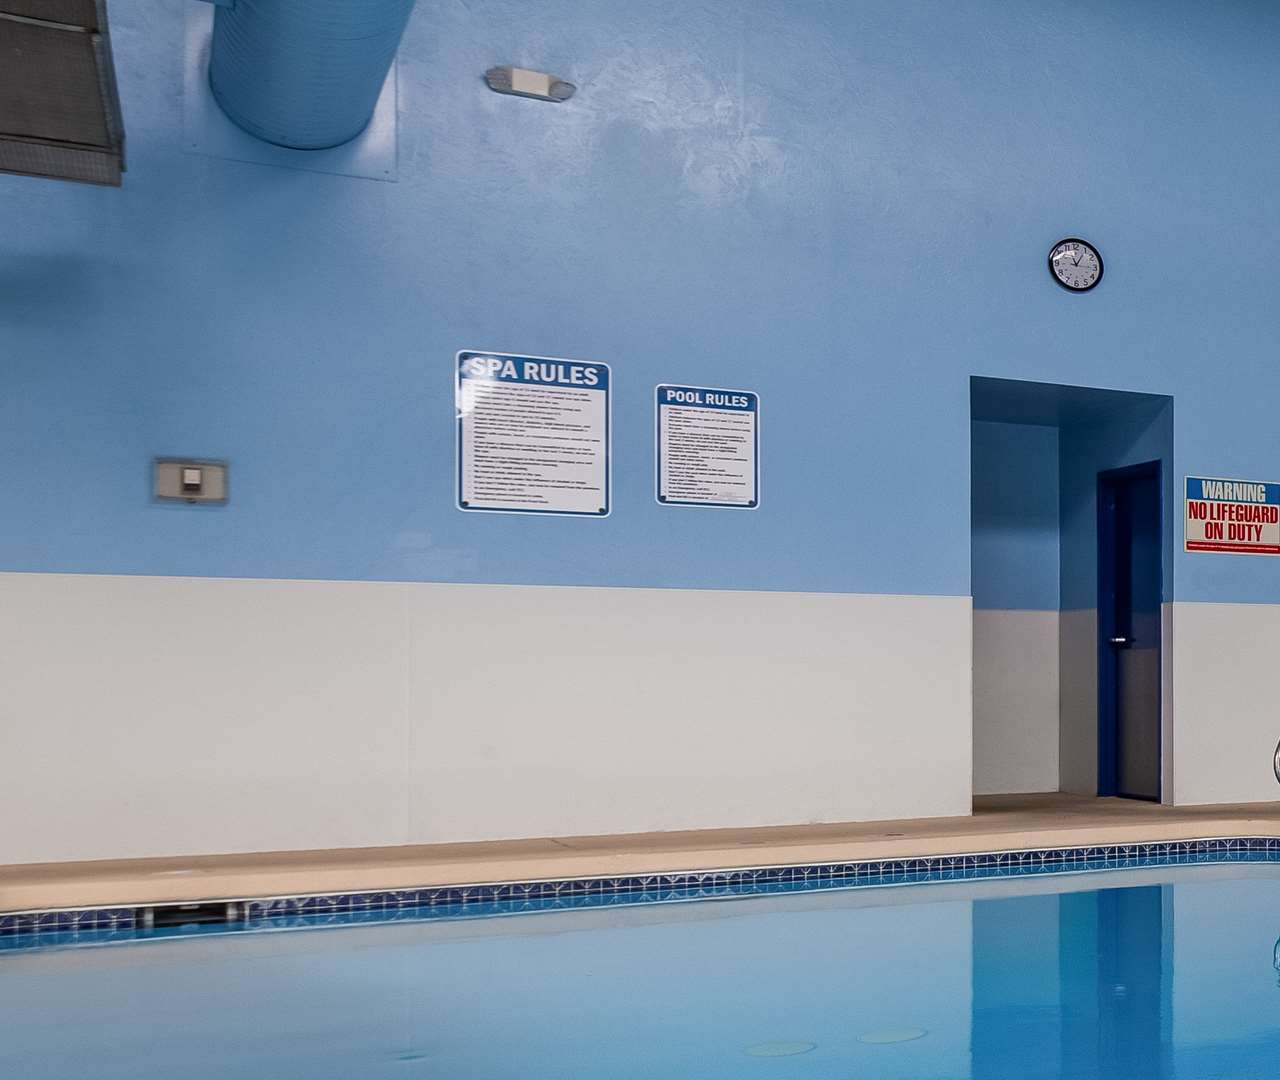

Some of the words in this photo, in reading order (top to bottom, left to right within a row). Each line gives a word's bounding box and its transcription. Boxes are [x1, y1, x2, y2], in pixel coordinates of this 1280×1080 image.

[469, 356, 519, 379] SPA
[524, 361, 599, 386] RULES
[666, 389, 703, 404] POOL
[705, 393, 748, 408] RULES
[1202, 480, 1266, 502] WARNING
[1188, 501, 1207, 520] NO
[1209, 502, 1279, 524] LIFEGUARD
[1204, 521, 1223, 540] ON
[1228, 522, 1263, 541] DUTY
